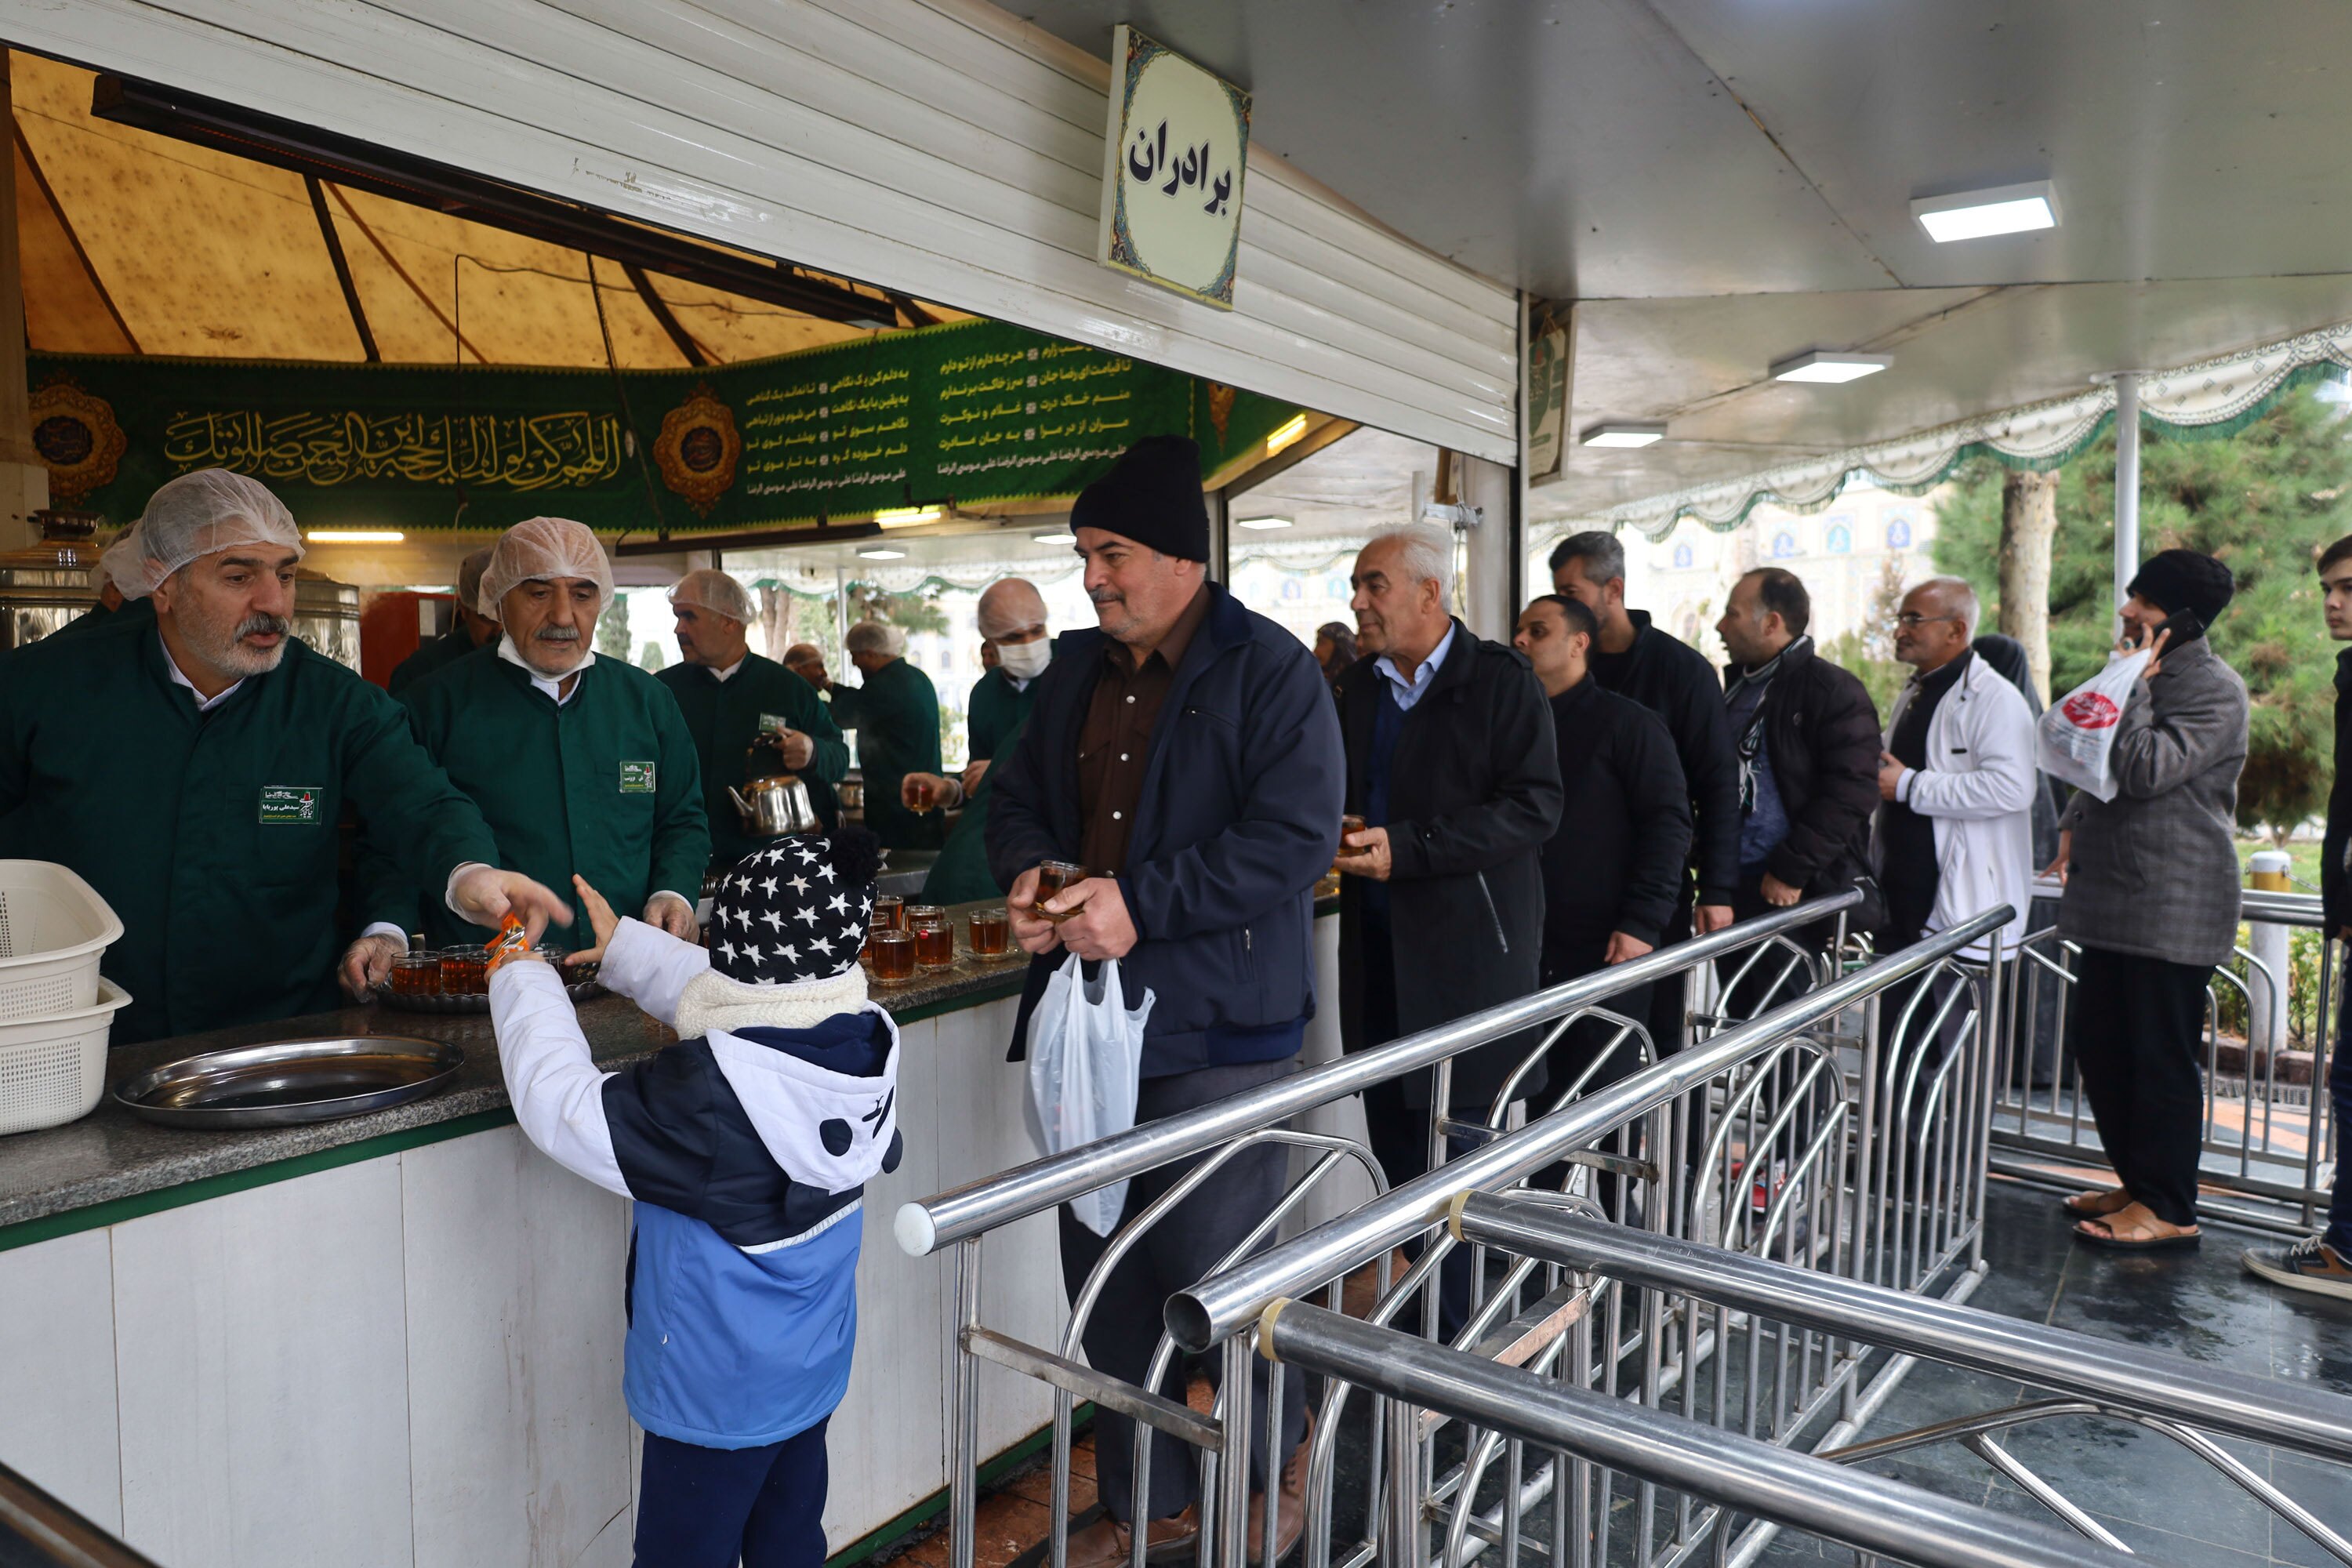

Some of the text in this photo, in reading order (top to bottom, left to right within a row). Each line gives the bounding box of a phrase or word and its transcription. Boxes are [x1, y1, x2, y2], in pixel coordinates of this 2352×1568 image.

[1128, 118, 1232, 218] برادران
[940, 390, 1131, 426] منم خاک درت غلام و نوکرت
[938, 417, 1130, 452] مران از در مرا به جان مادرت
